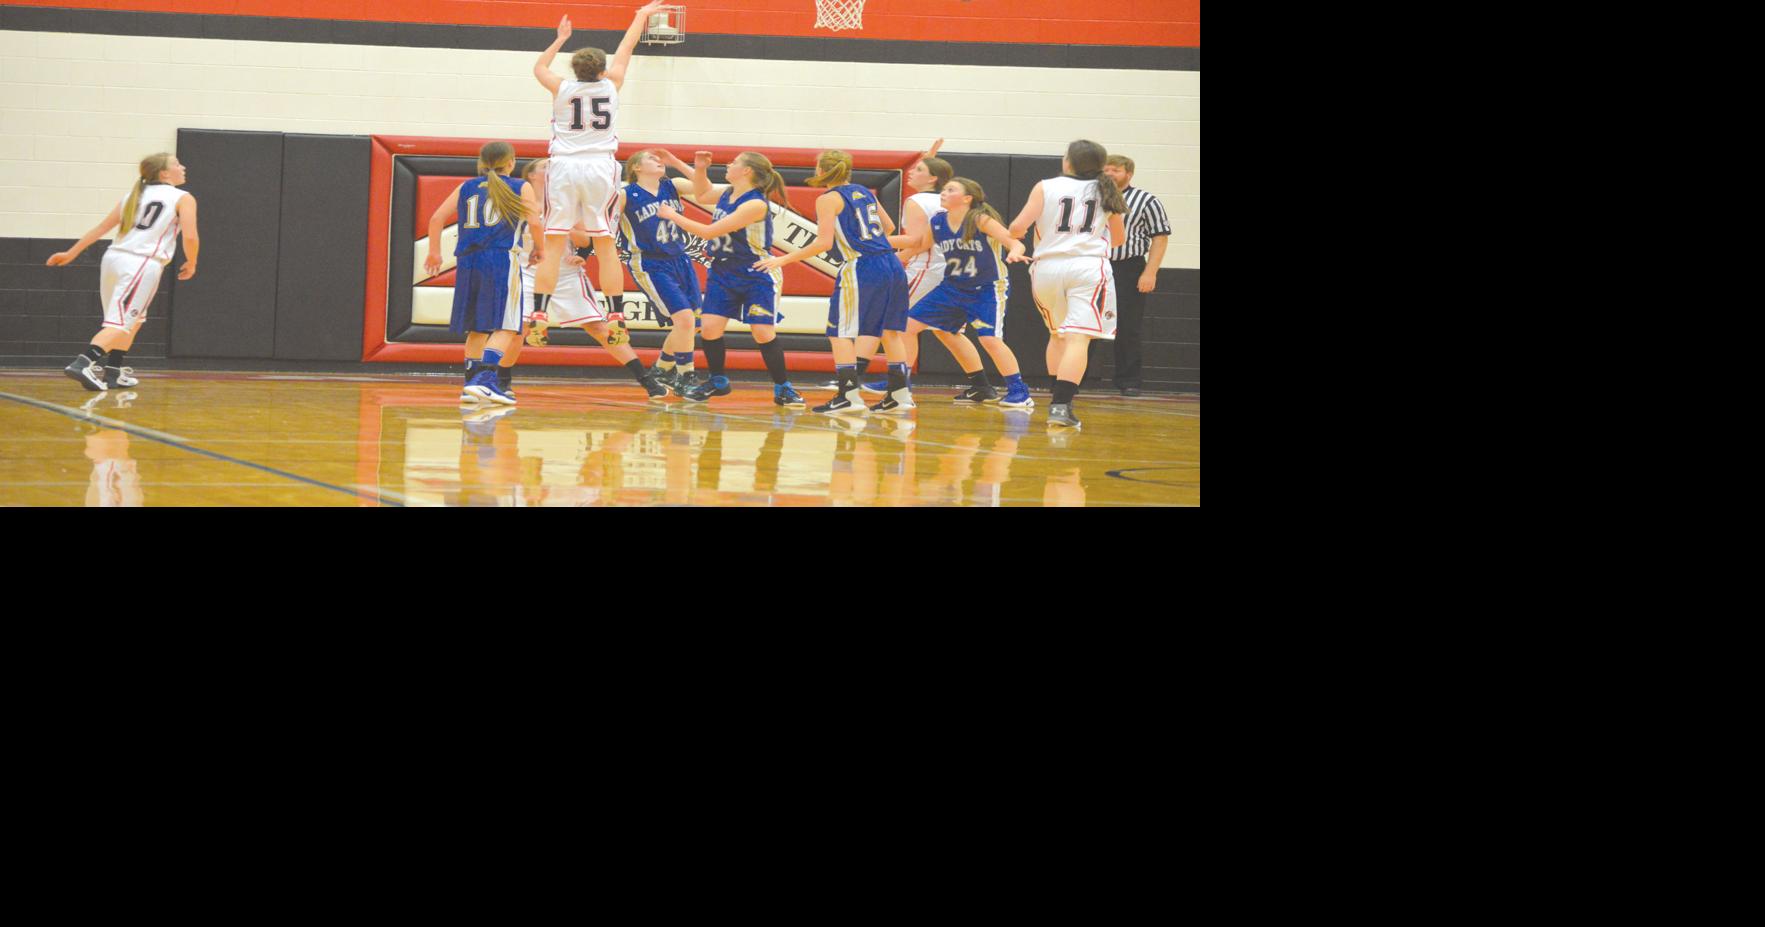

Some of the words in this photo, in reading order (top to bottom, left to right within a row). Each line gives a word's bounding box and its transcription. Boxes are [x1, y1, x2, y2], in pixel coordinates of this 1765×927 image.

[569, 97, 612, 130] 15
[464, 195, 502, 228] 10
[856, 203, 883, 241] 15
[1057, 197, 1097, 233] 11
[656, 220, 679, 244] 42
[956, 238, 983, 252] CATS
[947, 255, 978, 278] 24
